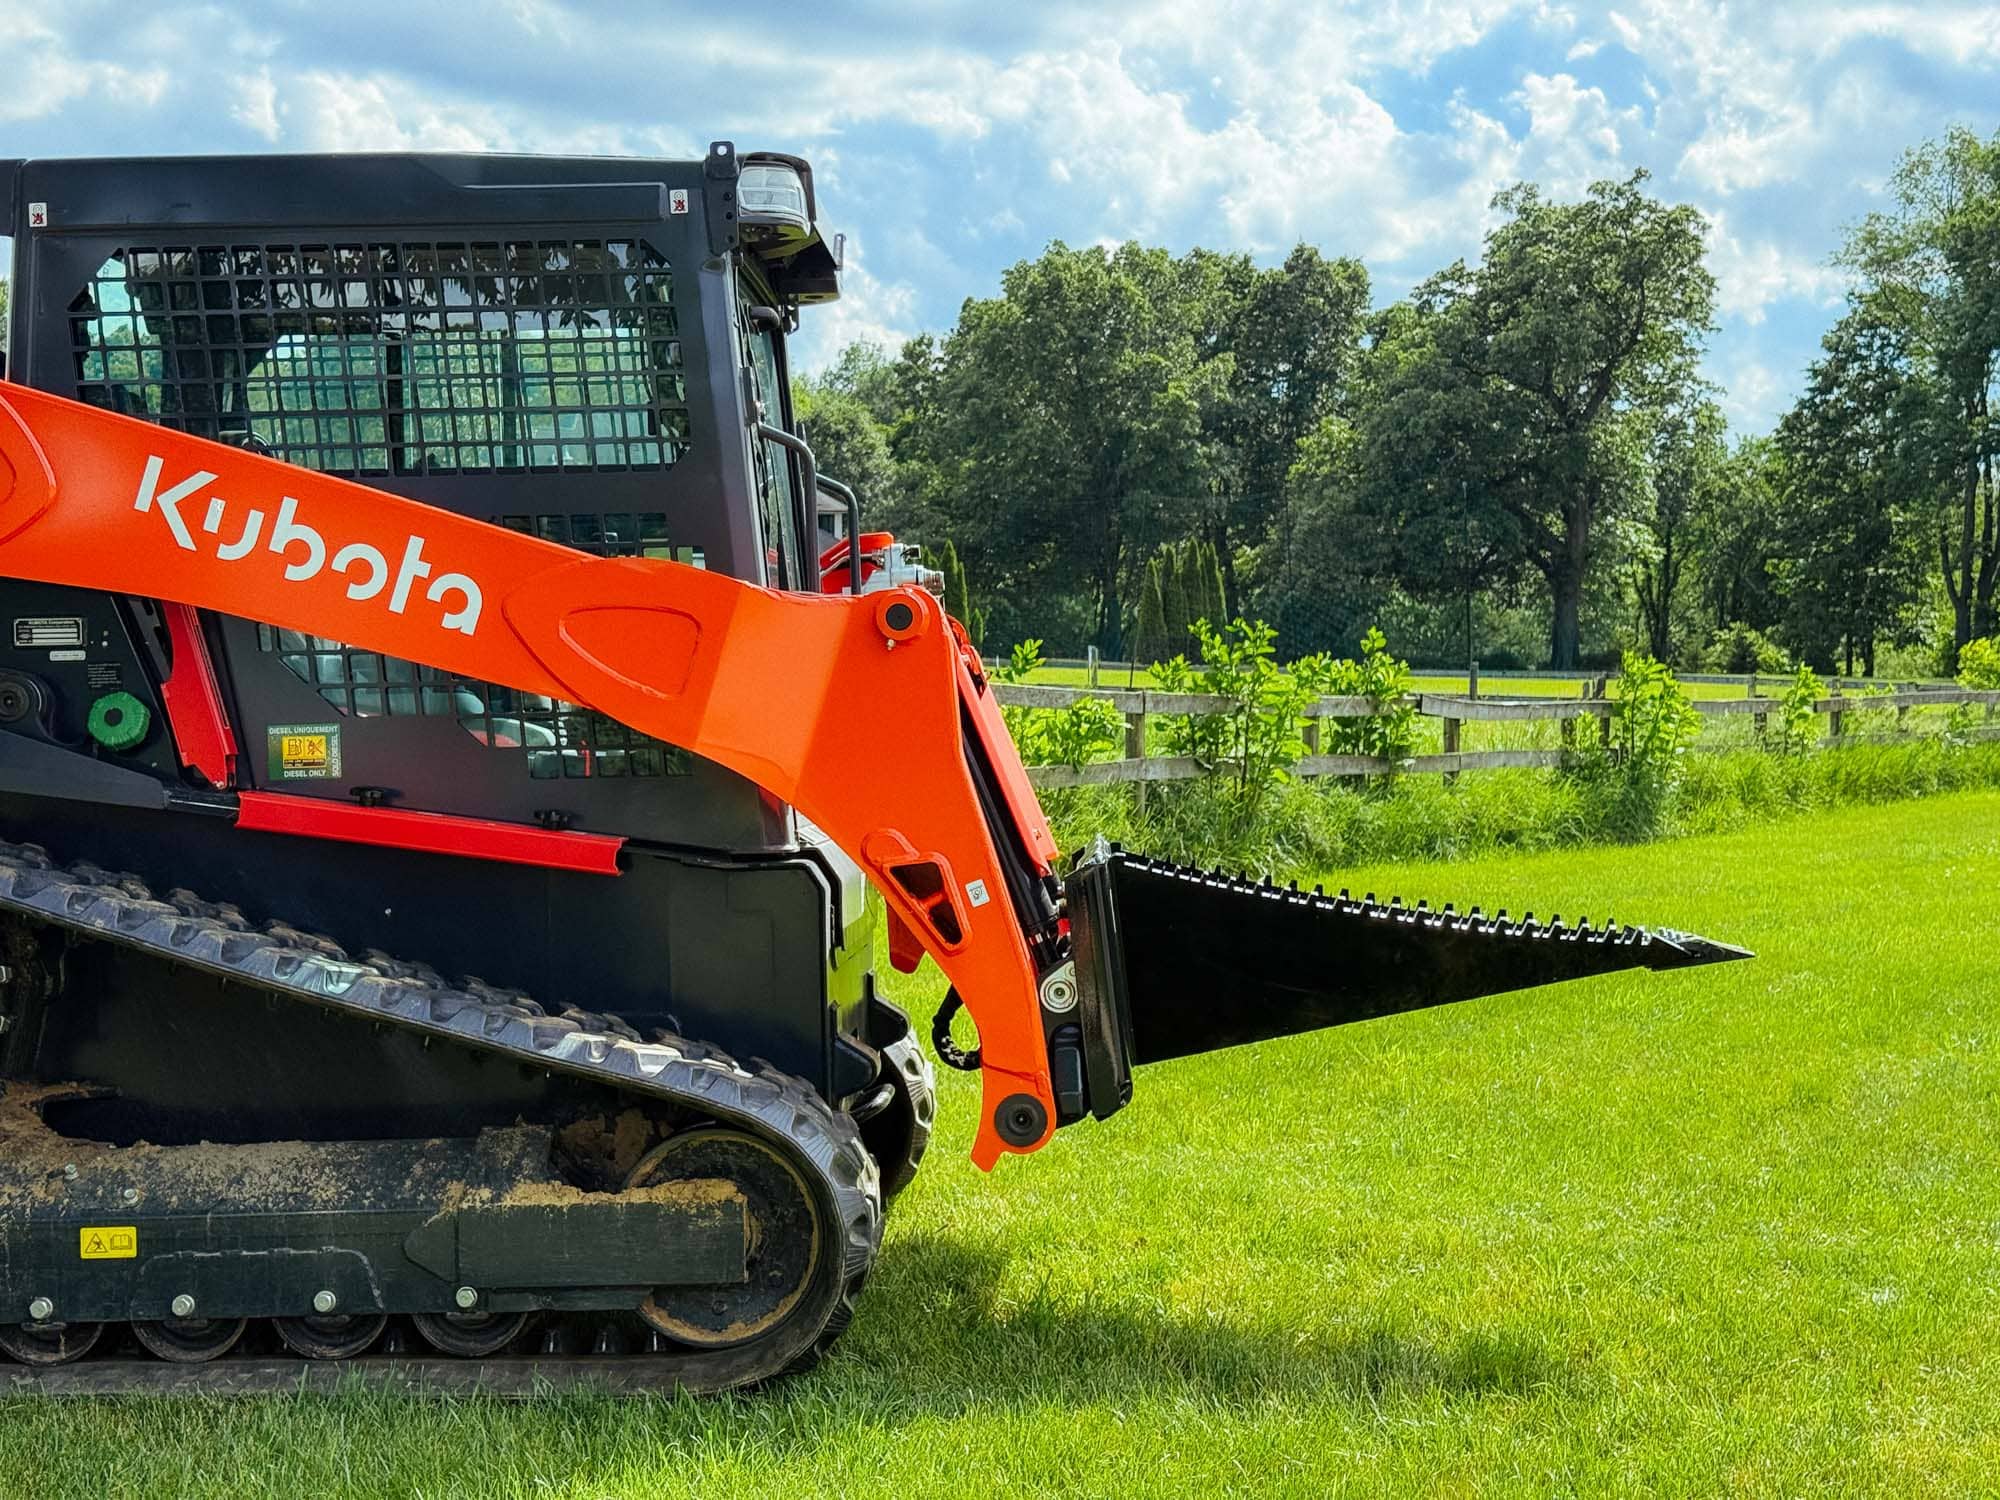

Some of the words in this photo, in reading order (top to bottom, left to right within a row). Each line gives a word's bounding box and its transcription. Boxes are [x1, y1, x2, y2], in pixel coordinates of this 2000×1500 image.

[134, 454, 483, 636] Kubota
[293, 726, 338, 734] UNIQUEMENT
[308, 769, 326, 777] ONLY
